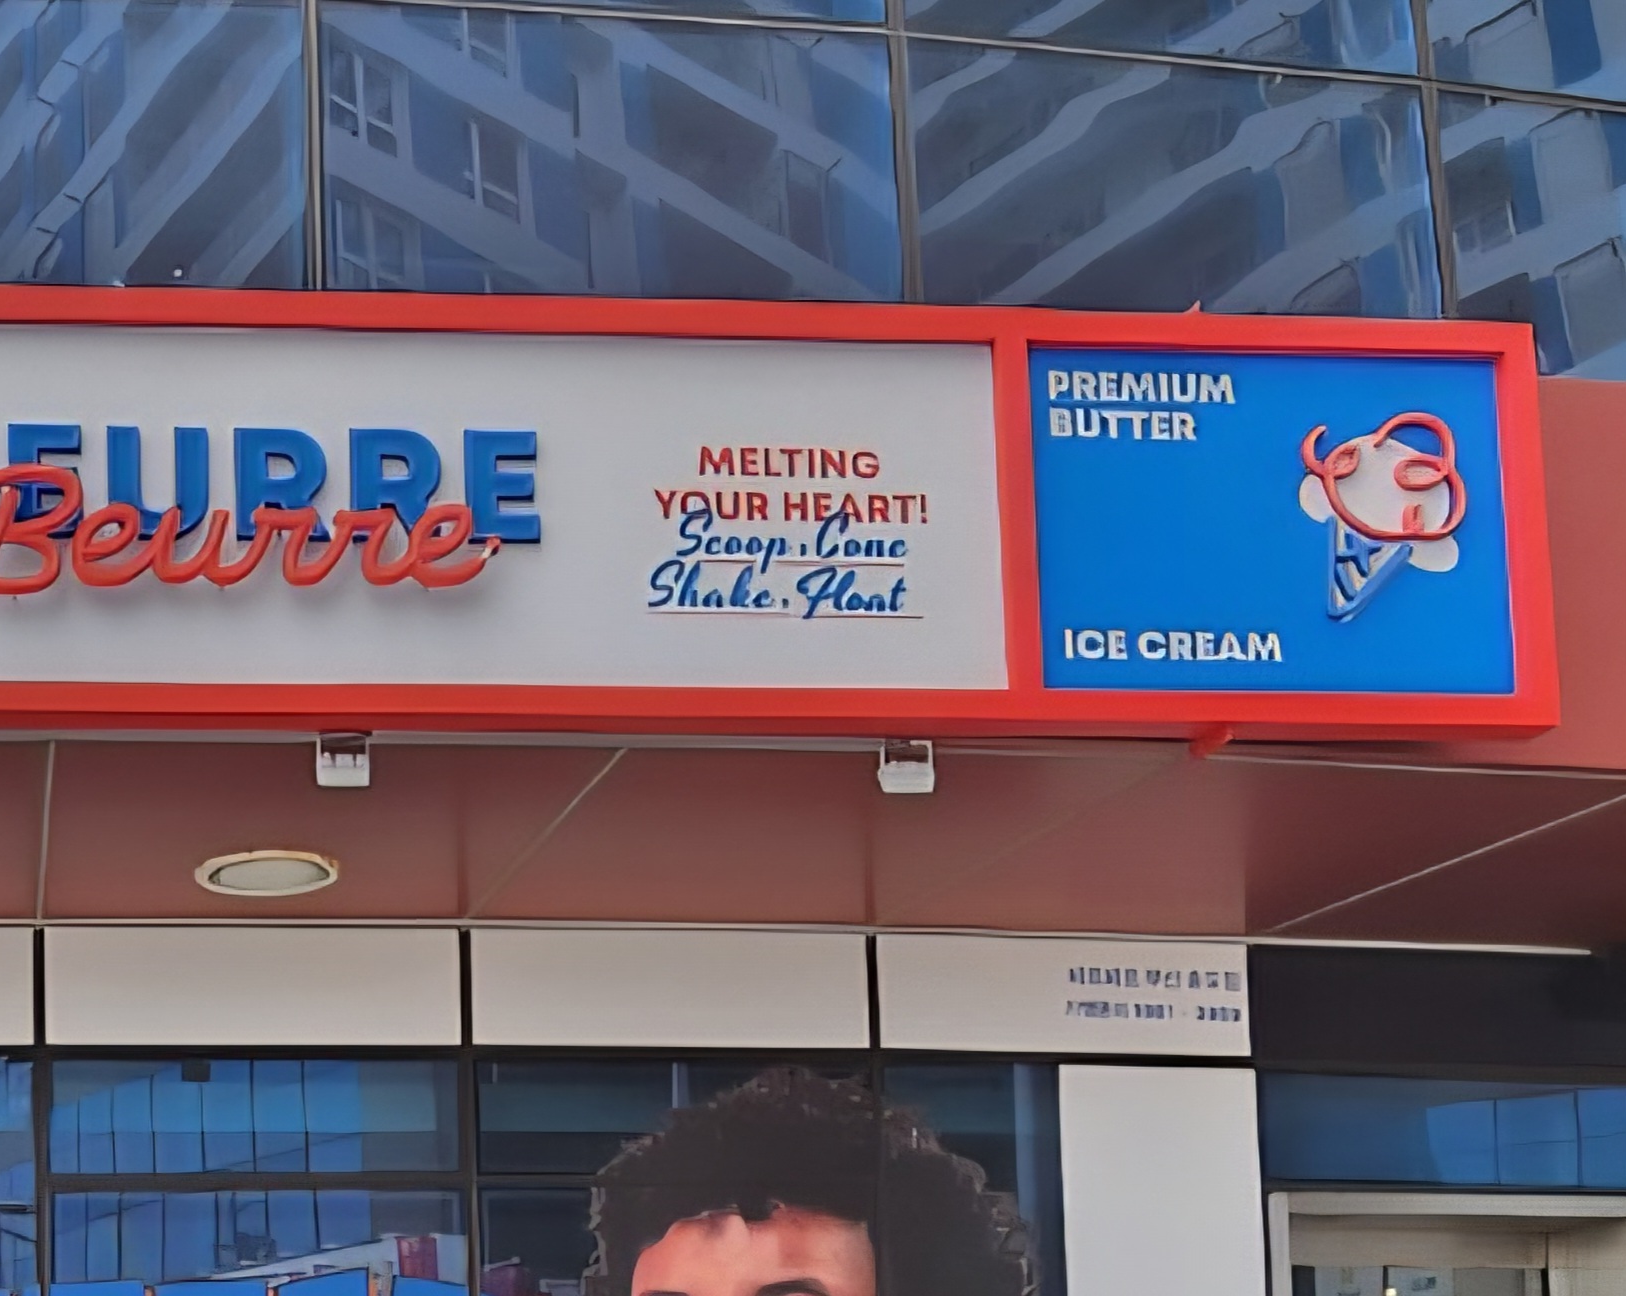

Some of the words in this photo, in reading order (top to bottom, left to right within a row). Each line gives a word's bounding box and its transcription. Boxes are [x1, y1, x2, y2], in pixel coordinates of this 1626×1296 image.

[1047, 369, 1236, 404] PREMIUM
[1048, 407, 1197, 441] BUTTER
[698, 445, 881, 479] MELTING
[653, 488, 768, 521] YOUR
[783, 491, 928, 524] HEART!
[1063, 628, 1128, 661] ICE
[1138, 630, 1283, 663] CREAM
